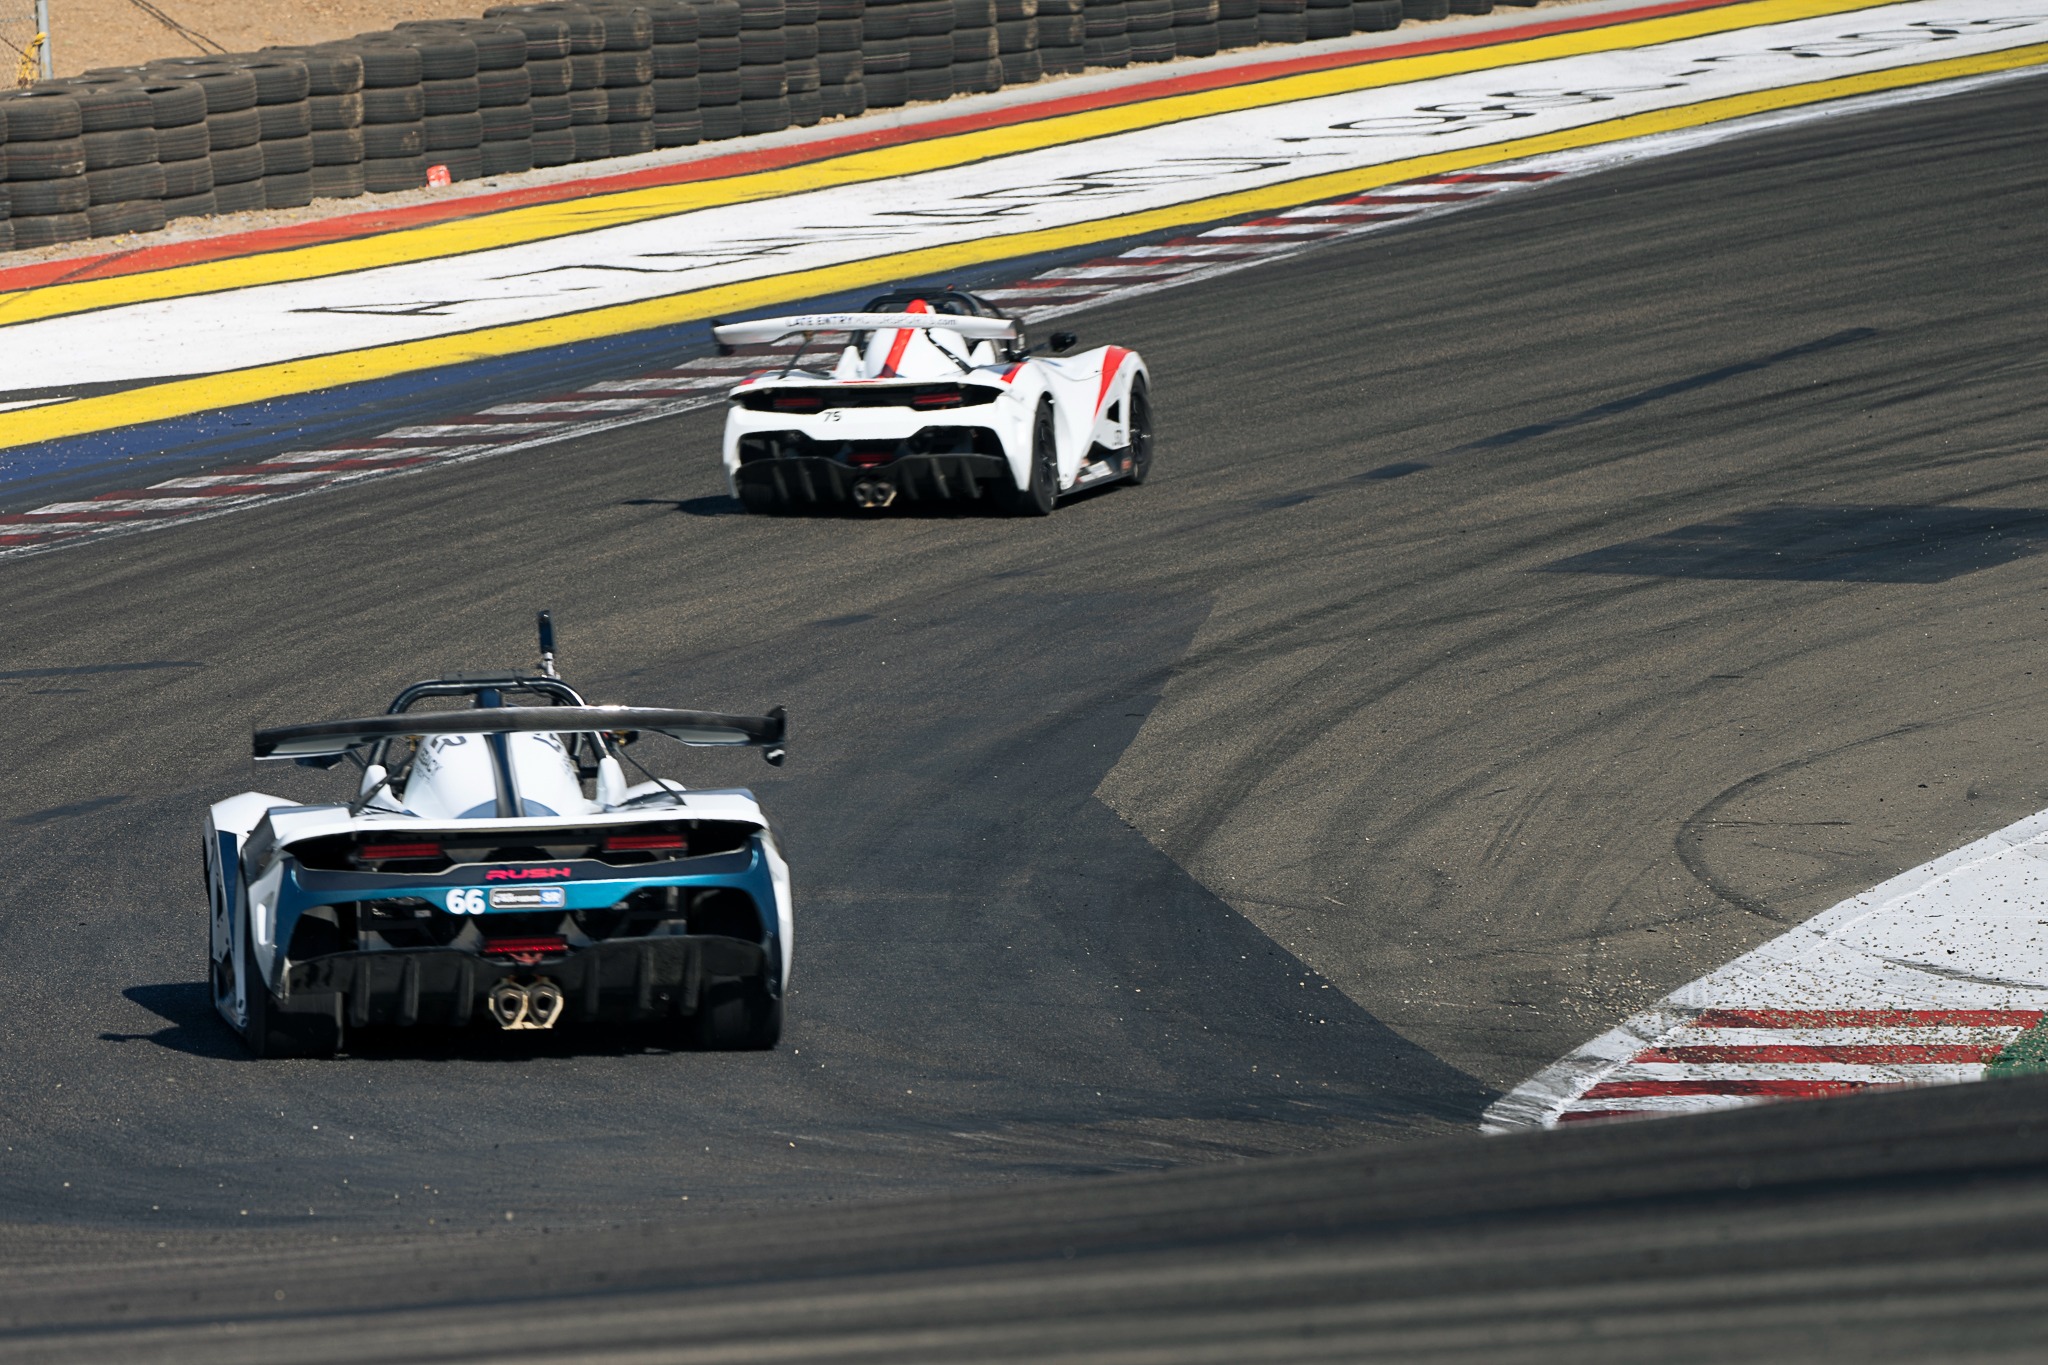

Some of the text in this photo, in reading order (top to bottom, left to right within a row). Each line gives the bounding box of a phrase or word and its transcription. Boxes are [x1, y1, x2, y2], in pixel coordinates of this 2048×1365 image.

[823, 410, 841, 422] 75
[485, 867, 571, 881] RUSH
[446, 888, 487, 915] 66
